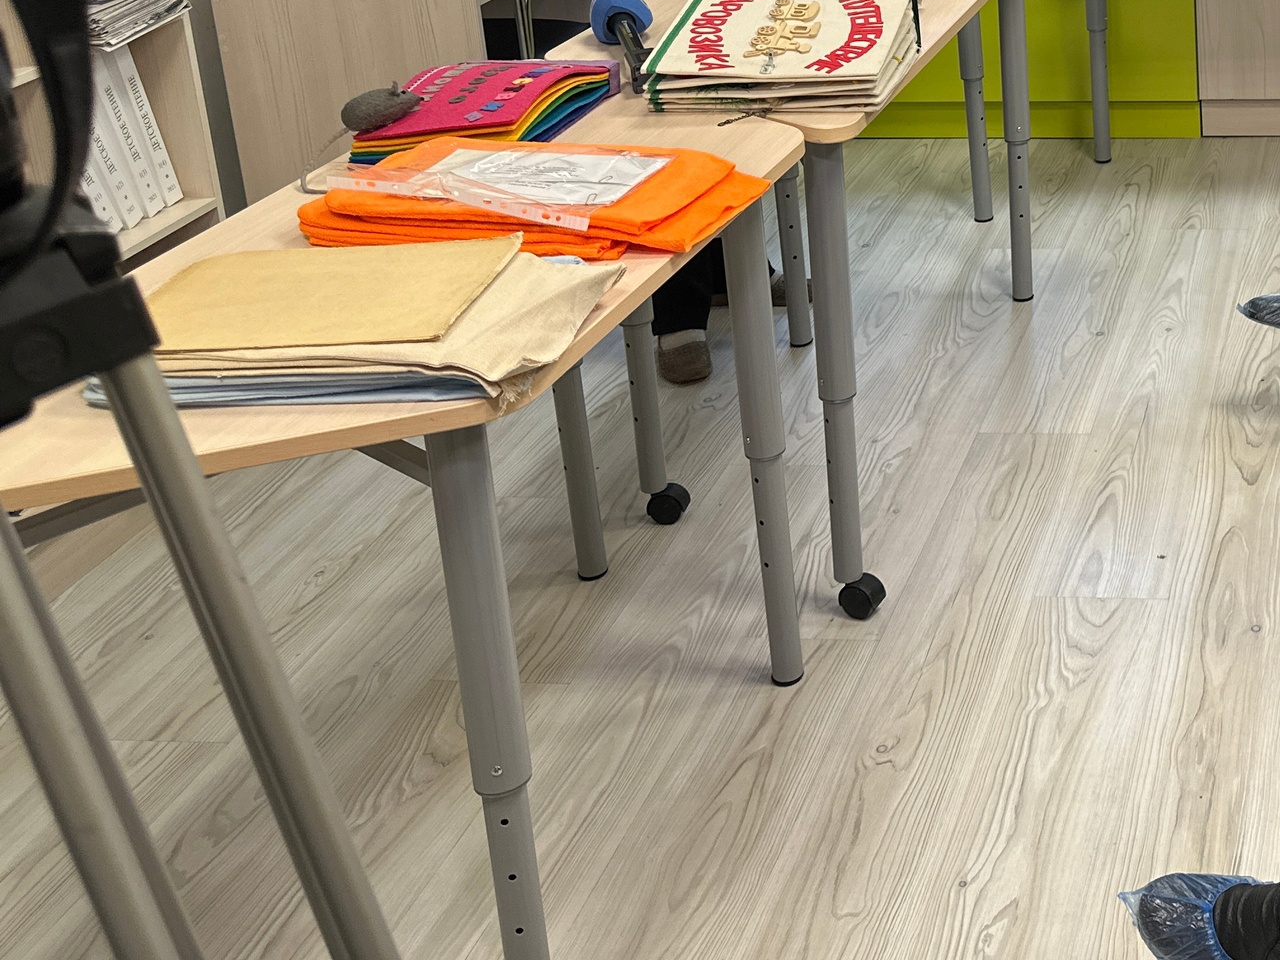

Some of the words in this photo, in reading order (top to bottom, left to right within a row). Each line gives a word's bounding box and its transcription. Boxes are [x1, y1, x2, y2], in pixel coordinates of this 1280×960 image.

[105, 85, 123, 122] ЧТЕНИЕ
[127, 74, 146, 110] ЧТЕНИЕ
[118, 121, 142, 163] ДЕТСКОЕ
[139, 109, 162, 152] ДЕТСКОЕ
[93, 133, 118, 175] ДЕТСКОЕ
